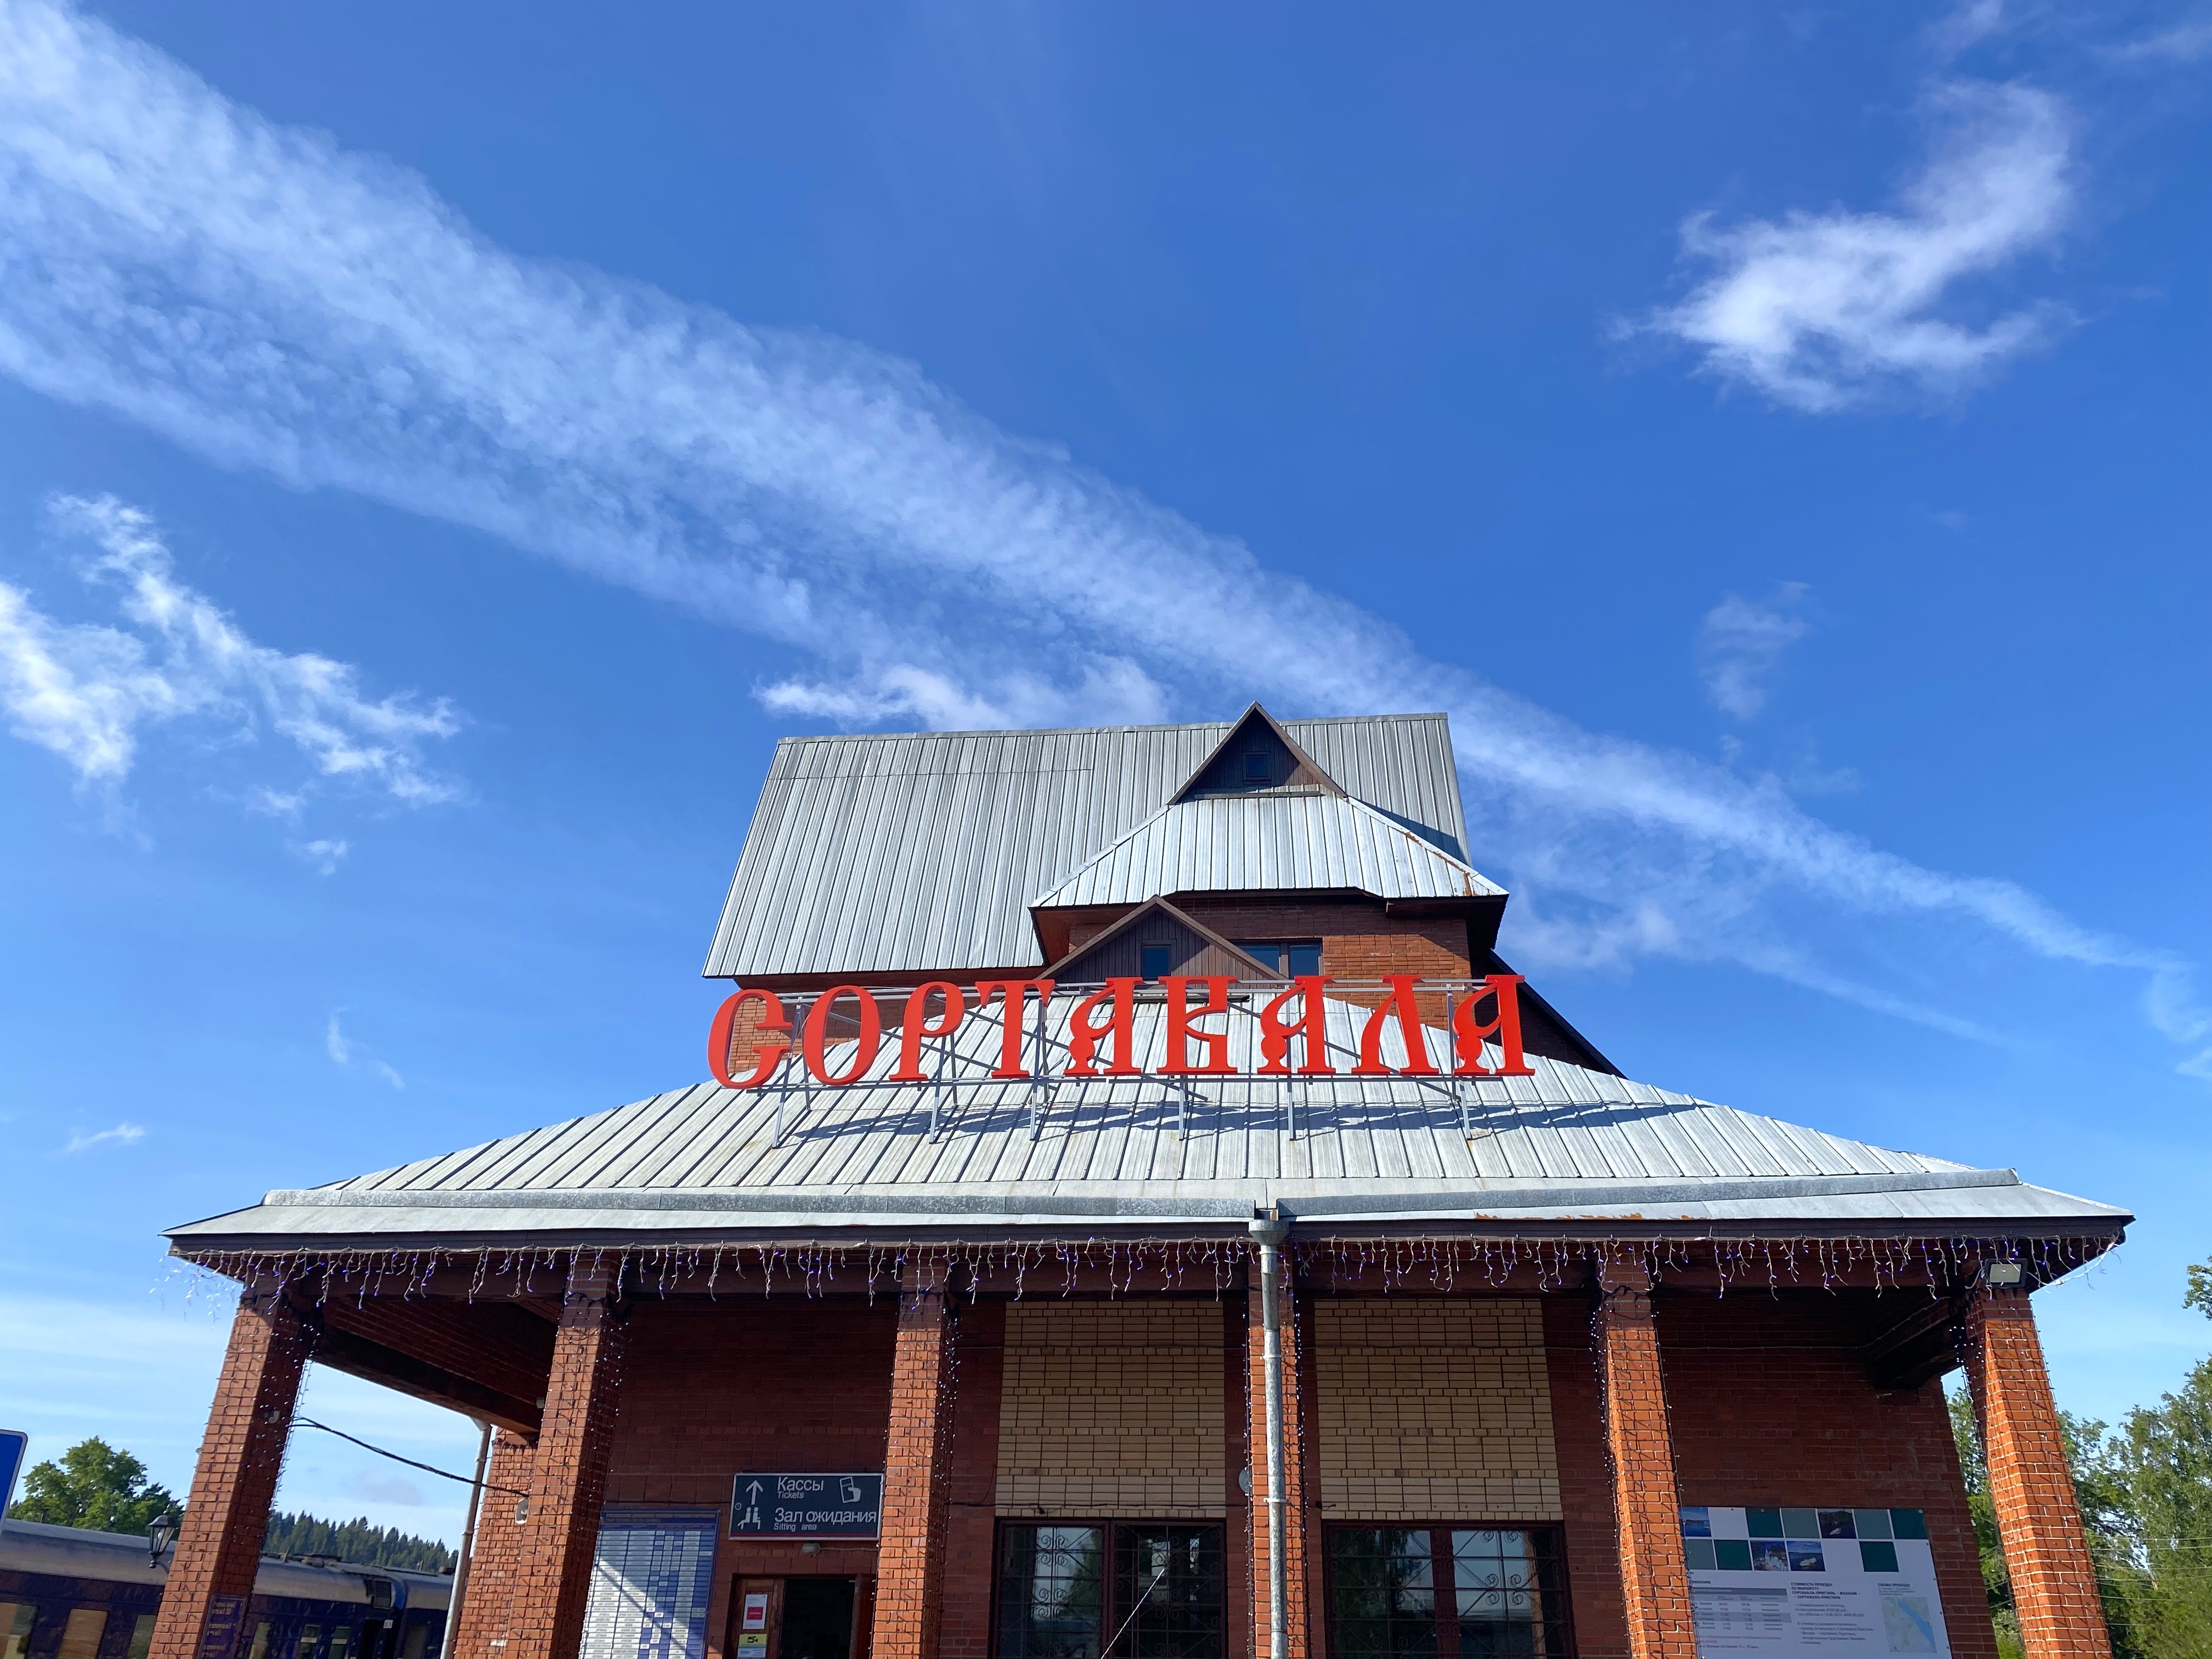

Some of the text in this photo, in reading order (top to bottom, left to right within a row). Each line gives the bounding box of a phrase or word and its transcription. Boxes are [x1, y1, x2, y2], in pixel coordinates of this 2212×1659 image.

[708, 975, 1535, 1089] СОРТАВАЛА
[777, 1476, 824, 1491] Кассы
[777, 1491, 804, 1499] Tickets
[774, 1507, 877, 1525] Зал ожидания
[773, 1522, 796, 1532] Sitting
